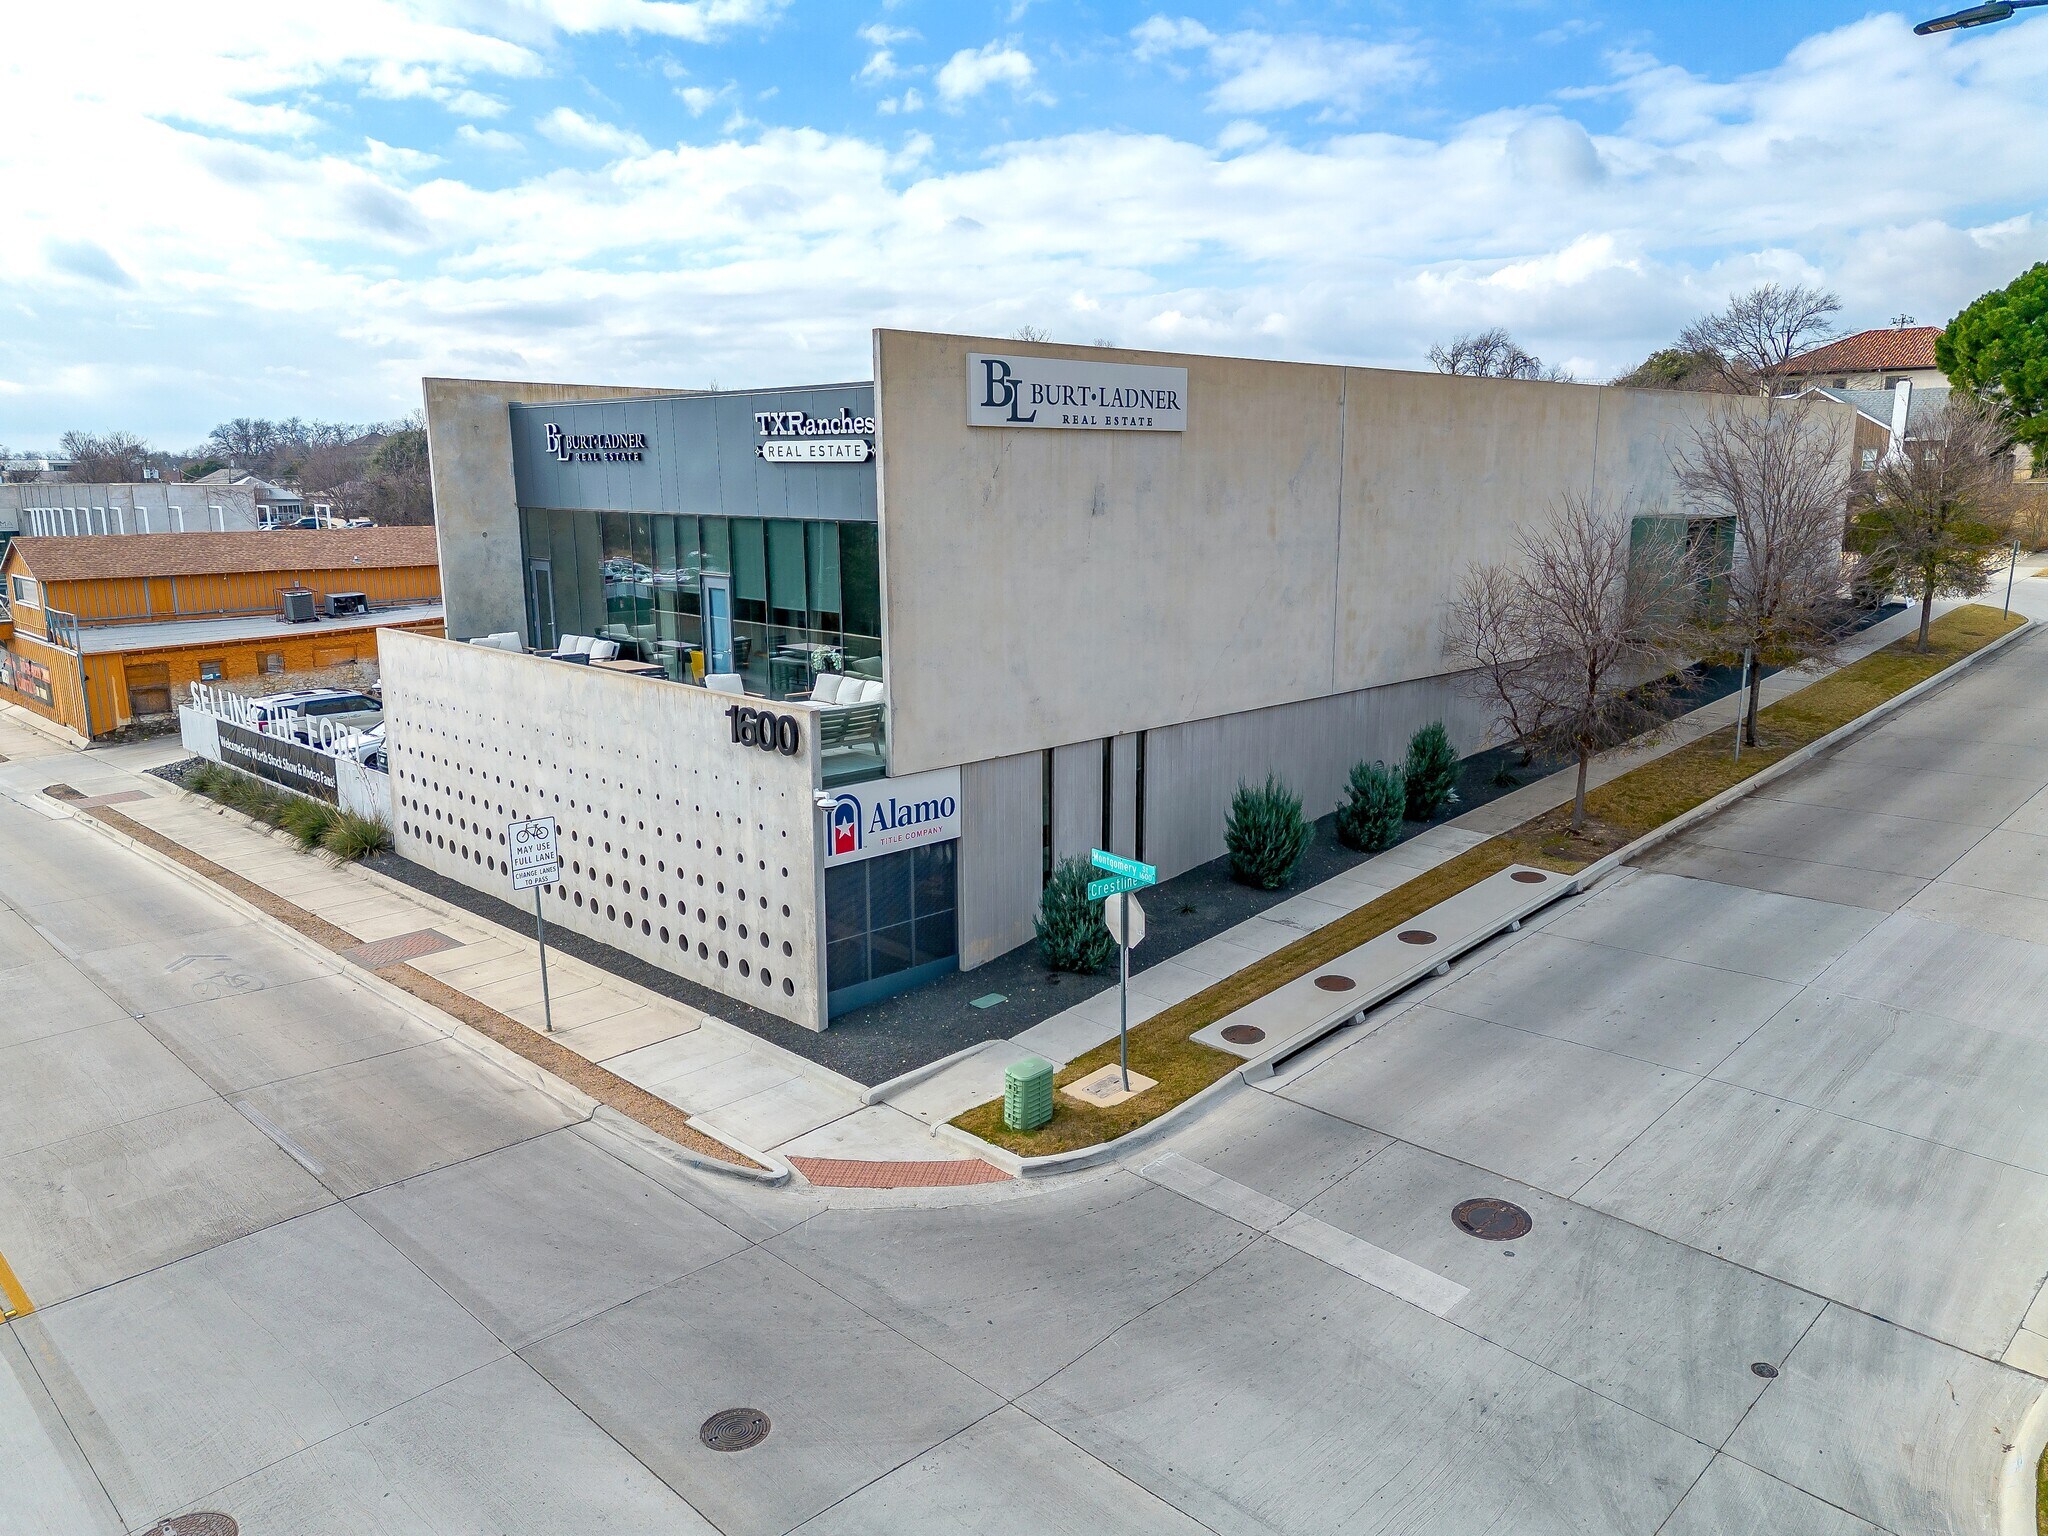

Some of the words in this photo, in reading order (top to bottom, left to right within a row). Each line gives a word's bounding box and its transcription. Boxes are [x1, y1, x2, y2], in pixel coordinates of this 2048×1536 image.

[754, 407, 875, 436] TXRanches
[1062, 414, 1097, 425] REAL
[1105, 415, 1153, 427] ESTATE
[575, 453, 599, 461] REAL
[603, 452, 639, 461] ESTATE
[768, 446, 802, 457] REAL
[809, 445, 862, 457] ESTATE
[189, 680, 260, 733] SELLING
[263, 702, 299, 741] THE
[725, 705, 800, 756] 1600
[219, 735, 242, 754] Welcome
[240, 743, 252, 758] Fort
[250, 747, 269, 764] Worth
[267, 753, 283, 769] Stock
[282, 758, 298, 775] Show
[297, 763, 303, 776] &
[302, 764, 321, 783] Rodeo
[868, 796, 956, 834] Alamo
[880, 835, 903, 846] TITLE
[905, 826, 944, 840] COMPANY
[516, 845, 533, 855] MAY
[536, 842, 551, 851] USE
[514, 856, 532, 866] FULL
[535, 852, 555, 862] LANE
[1093, 852, 1137, 877] Montgomery
[515, 870, 538, 880] CHANGE
[539, 866, 557, 875] LANES
[535, 876, 549, 884] PASS
[1091, 877, 1138, 897] Crestline
